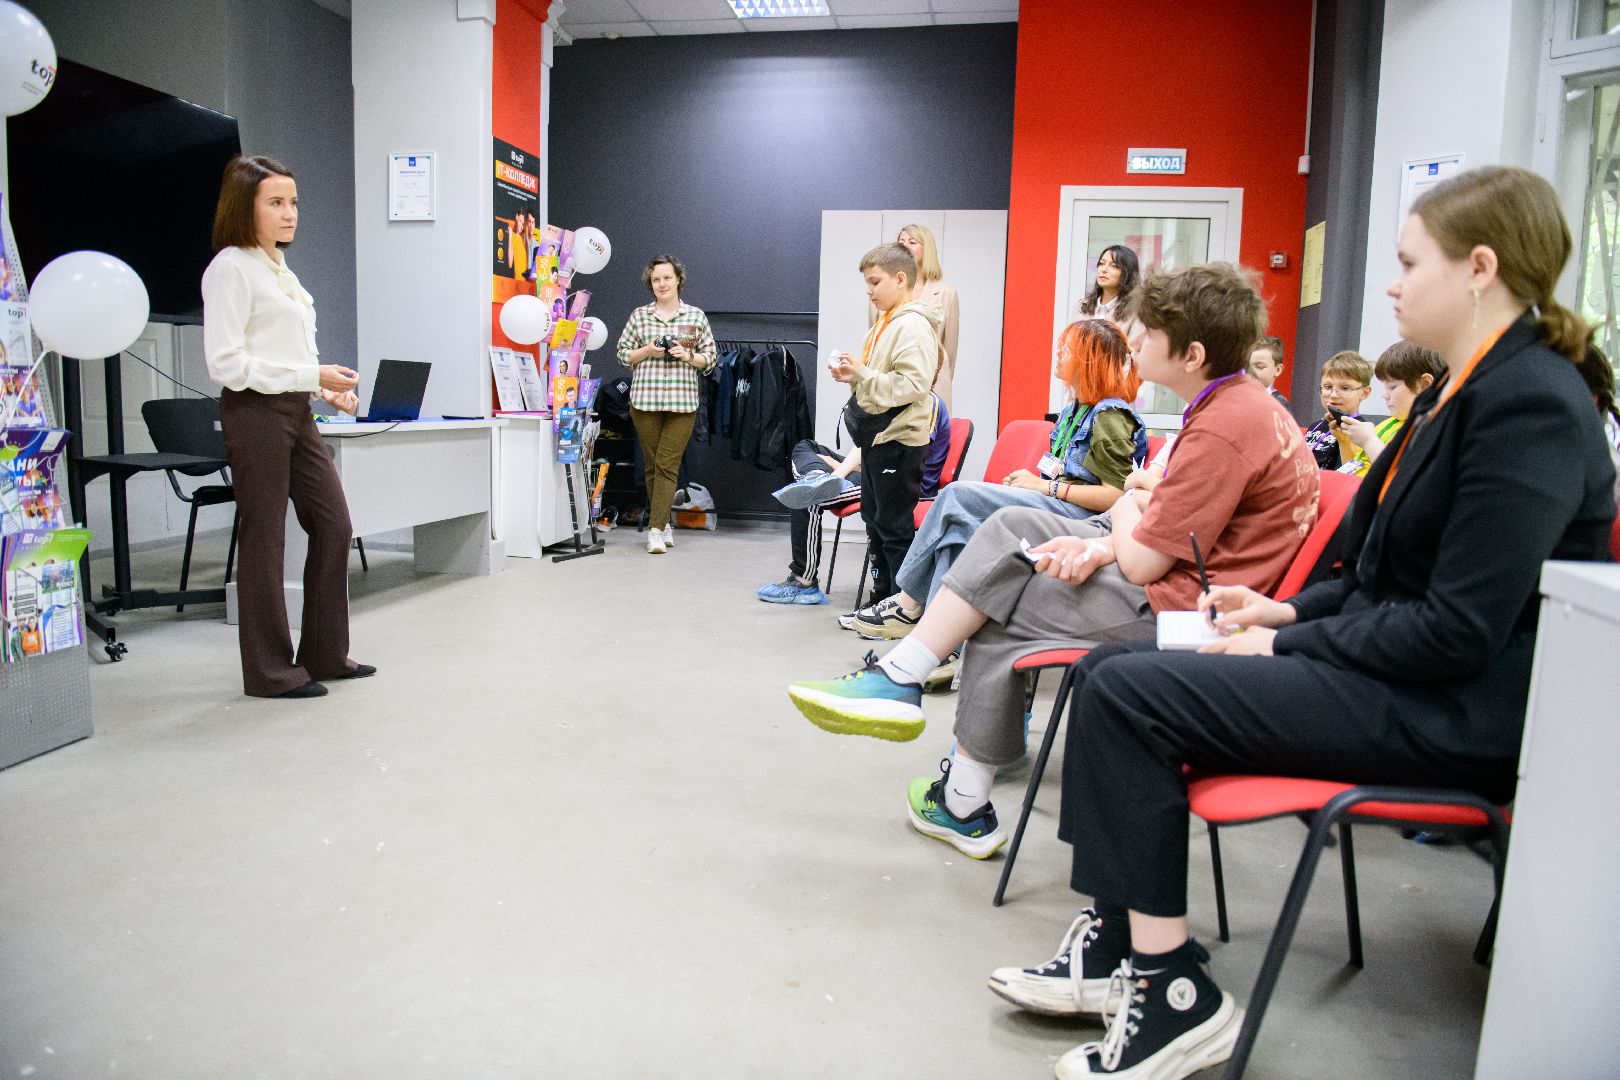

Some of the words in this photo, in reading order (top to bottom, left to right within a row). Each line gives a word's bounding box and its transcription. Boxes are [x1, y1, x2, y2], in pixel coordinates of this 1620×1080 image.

[1132, 157, 1181, 170] ВЫХОД
[589, 238, 603, 254] top
[8, 308, 26, 318] top
[5, 457, 38, 472] АНИ
[34, 533, 54, 545] top
